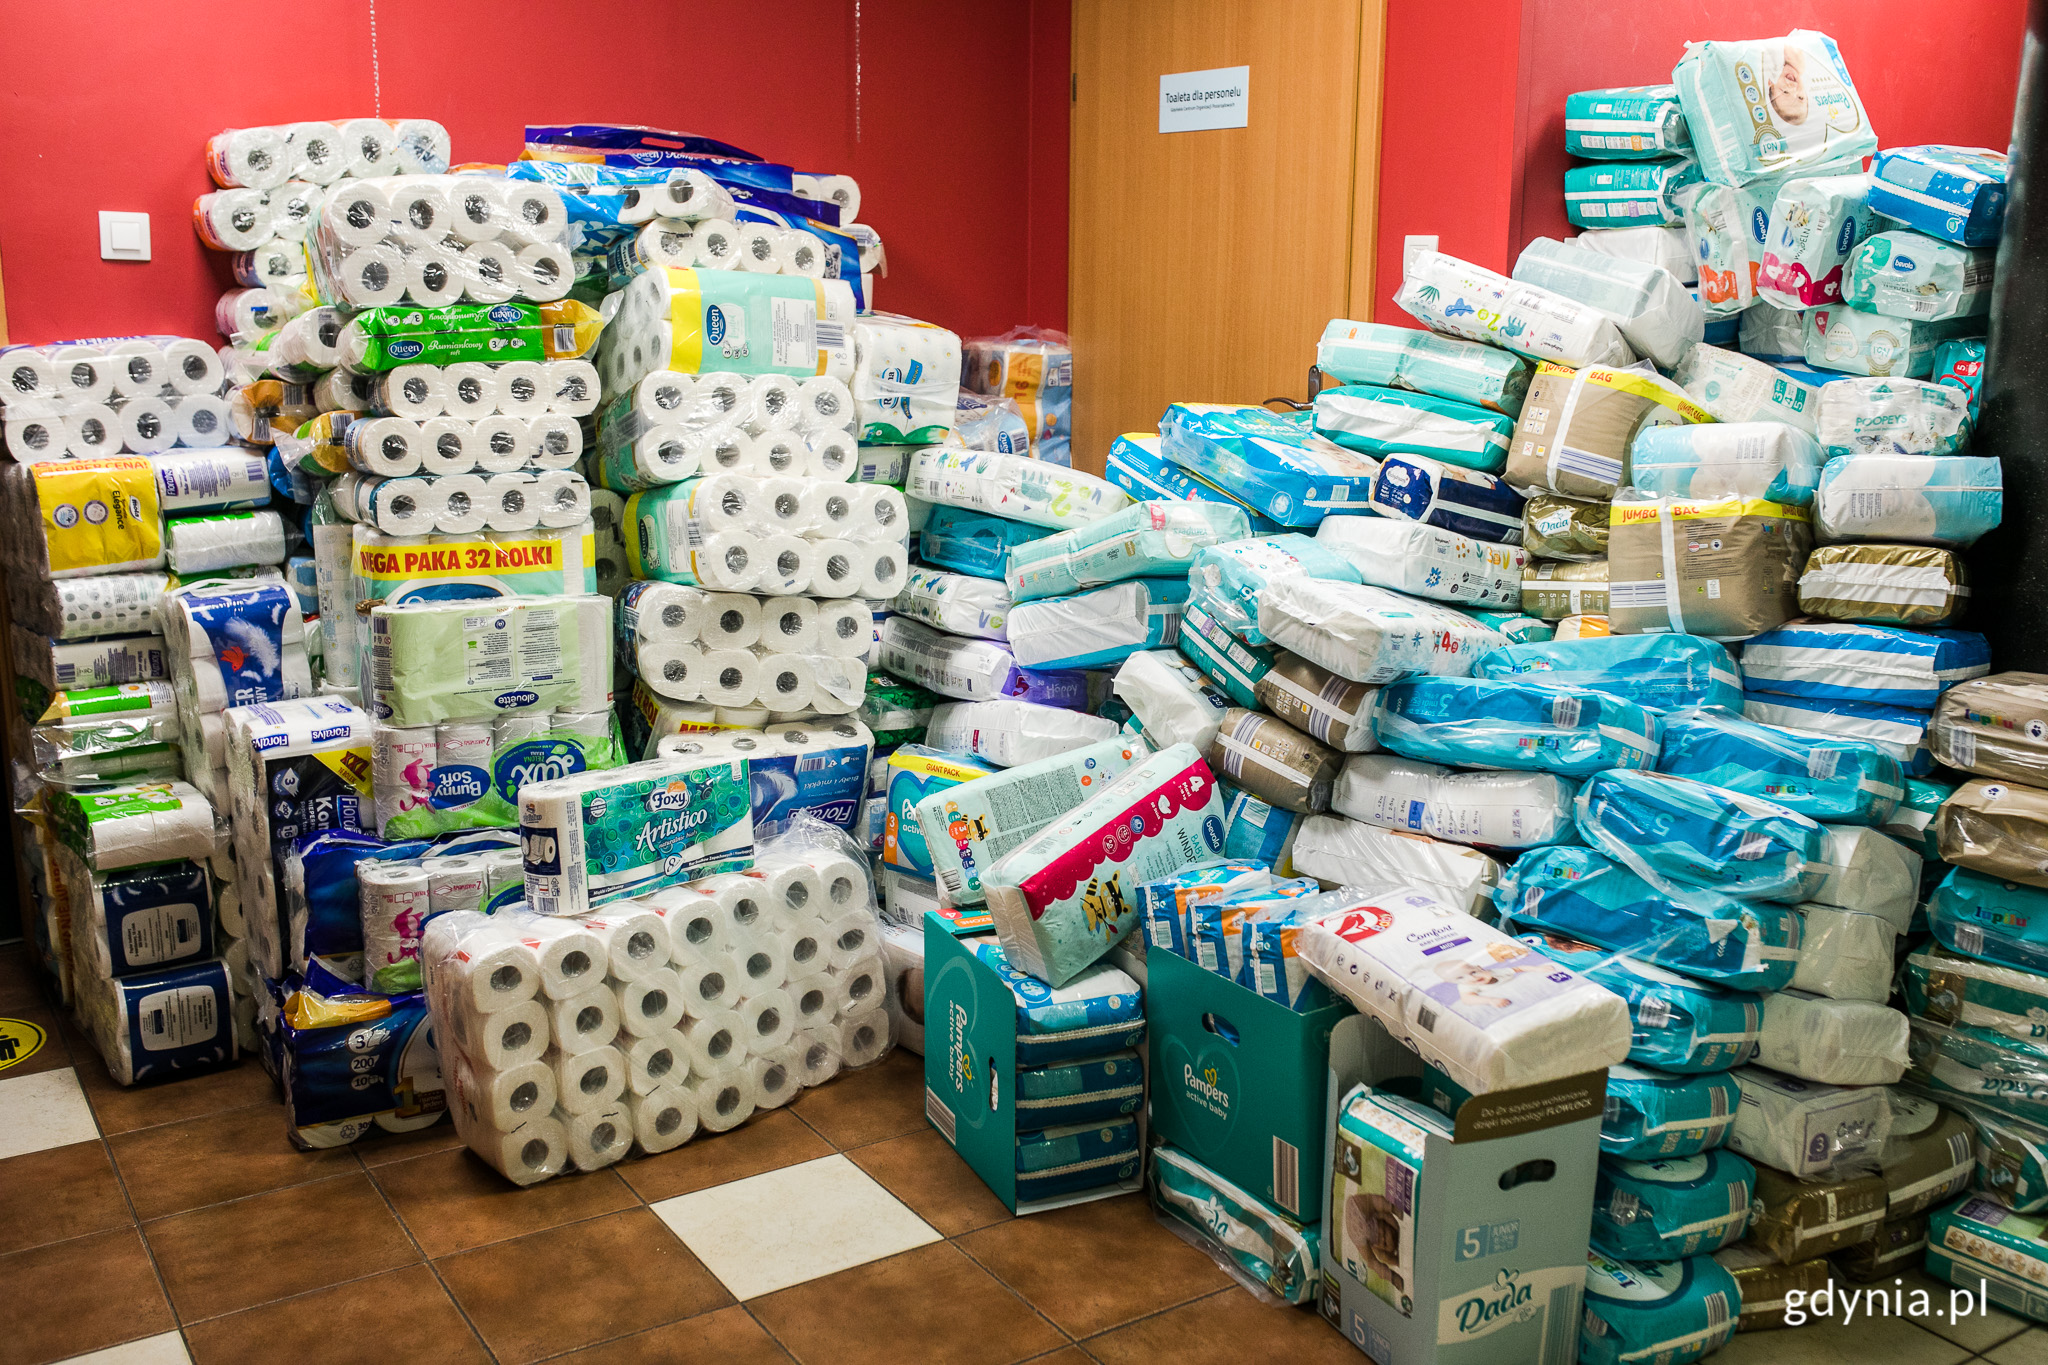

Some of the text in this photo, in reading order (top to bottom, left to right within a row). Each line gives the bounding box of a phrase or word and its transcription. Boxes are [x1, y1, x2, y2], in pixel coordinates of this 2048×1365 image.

[1165, 86, 1242, 103] Toaleta dla personelu
[1840, 222, 1854, 252] bevola
[1862, 245, 1876, 263] 2
[1894, 259, 1915, 270] bevola
[491, 308, 521, 321] Queen
[710, 309, 721, 345] Queen
[389, 344, 421, 356] Queen
[427, 339, 484, 352] Rumiankowy
[491, 340, 498, 349] 3
[1590, 371, 1613, 383] BAG
[1773, 394, 1783, 402] 3
[1784, 396, 1793, 405] 4
[1794, 400, 1804, 411] 5
[1855, 414, 1908, 427] POOPEYS
[112, 490, 125, 530] Elegance
[1623, 509, 1656, 522] JUMBO
[1540, 518, 1569, 534] Dada
[360, 546, 552, 573] MEGA PAKA 32 ROLKI
[1012, 674, 1030, 697] 5
[498, 691, 536, 707] alouette
[1440, 693, 1455, 717] 3
[1965, 708, 2014, 730] lupilu
[312, 726, 350, 743] Floralys
[1519, 736, 1560, 750] lupilu
[339, 751, 370, 782] XXL
[926, 763, 960, 778] GIANT PACK
[284, 776, 297, 787] 3
[439, 771, 472, 786] Soft
[1190, 775, 1205, 793] 4
[435, 780, 482, 797] Bunny
[651, 790, 686, 808] Foxy
[635, 808, 708, 853] Artistico
[890, 816, 897, 828] 3
[1653, 813, 1675, 836] 5
[283, 826, 293, 839] 16
[1205, 819, 1221, 850] bevola
[1190, 834, 1205, 859] BABY
[668, 855, 678, 872] 8
[1542, 864, 1581, 880] lupilu
[1976, 906, 2026, 928] lupilu
[1406, 924, 1453, 942] Comfort
[355, 1034, 366, 1050] 3
[955, 1004, 968, 1093] Pampers
[353, 1056, 374, 1070] 200
[354, 1076, 368, 1087] 10
[1184, 1063, 1229, 1108] Pampers
[1186, 1090, 1228, 1120] active baby
[1815, 1134, 1825, 1153] 3
[1463, 1227, 1481, 1259] 5
[1455, 1281, 1533, 1334] Dada
[1354, 1313, 1366, 1345] 5
